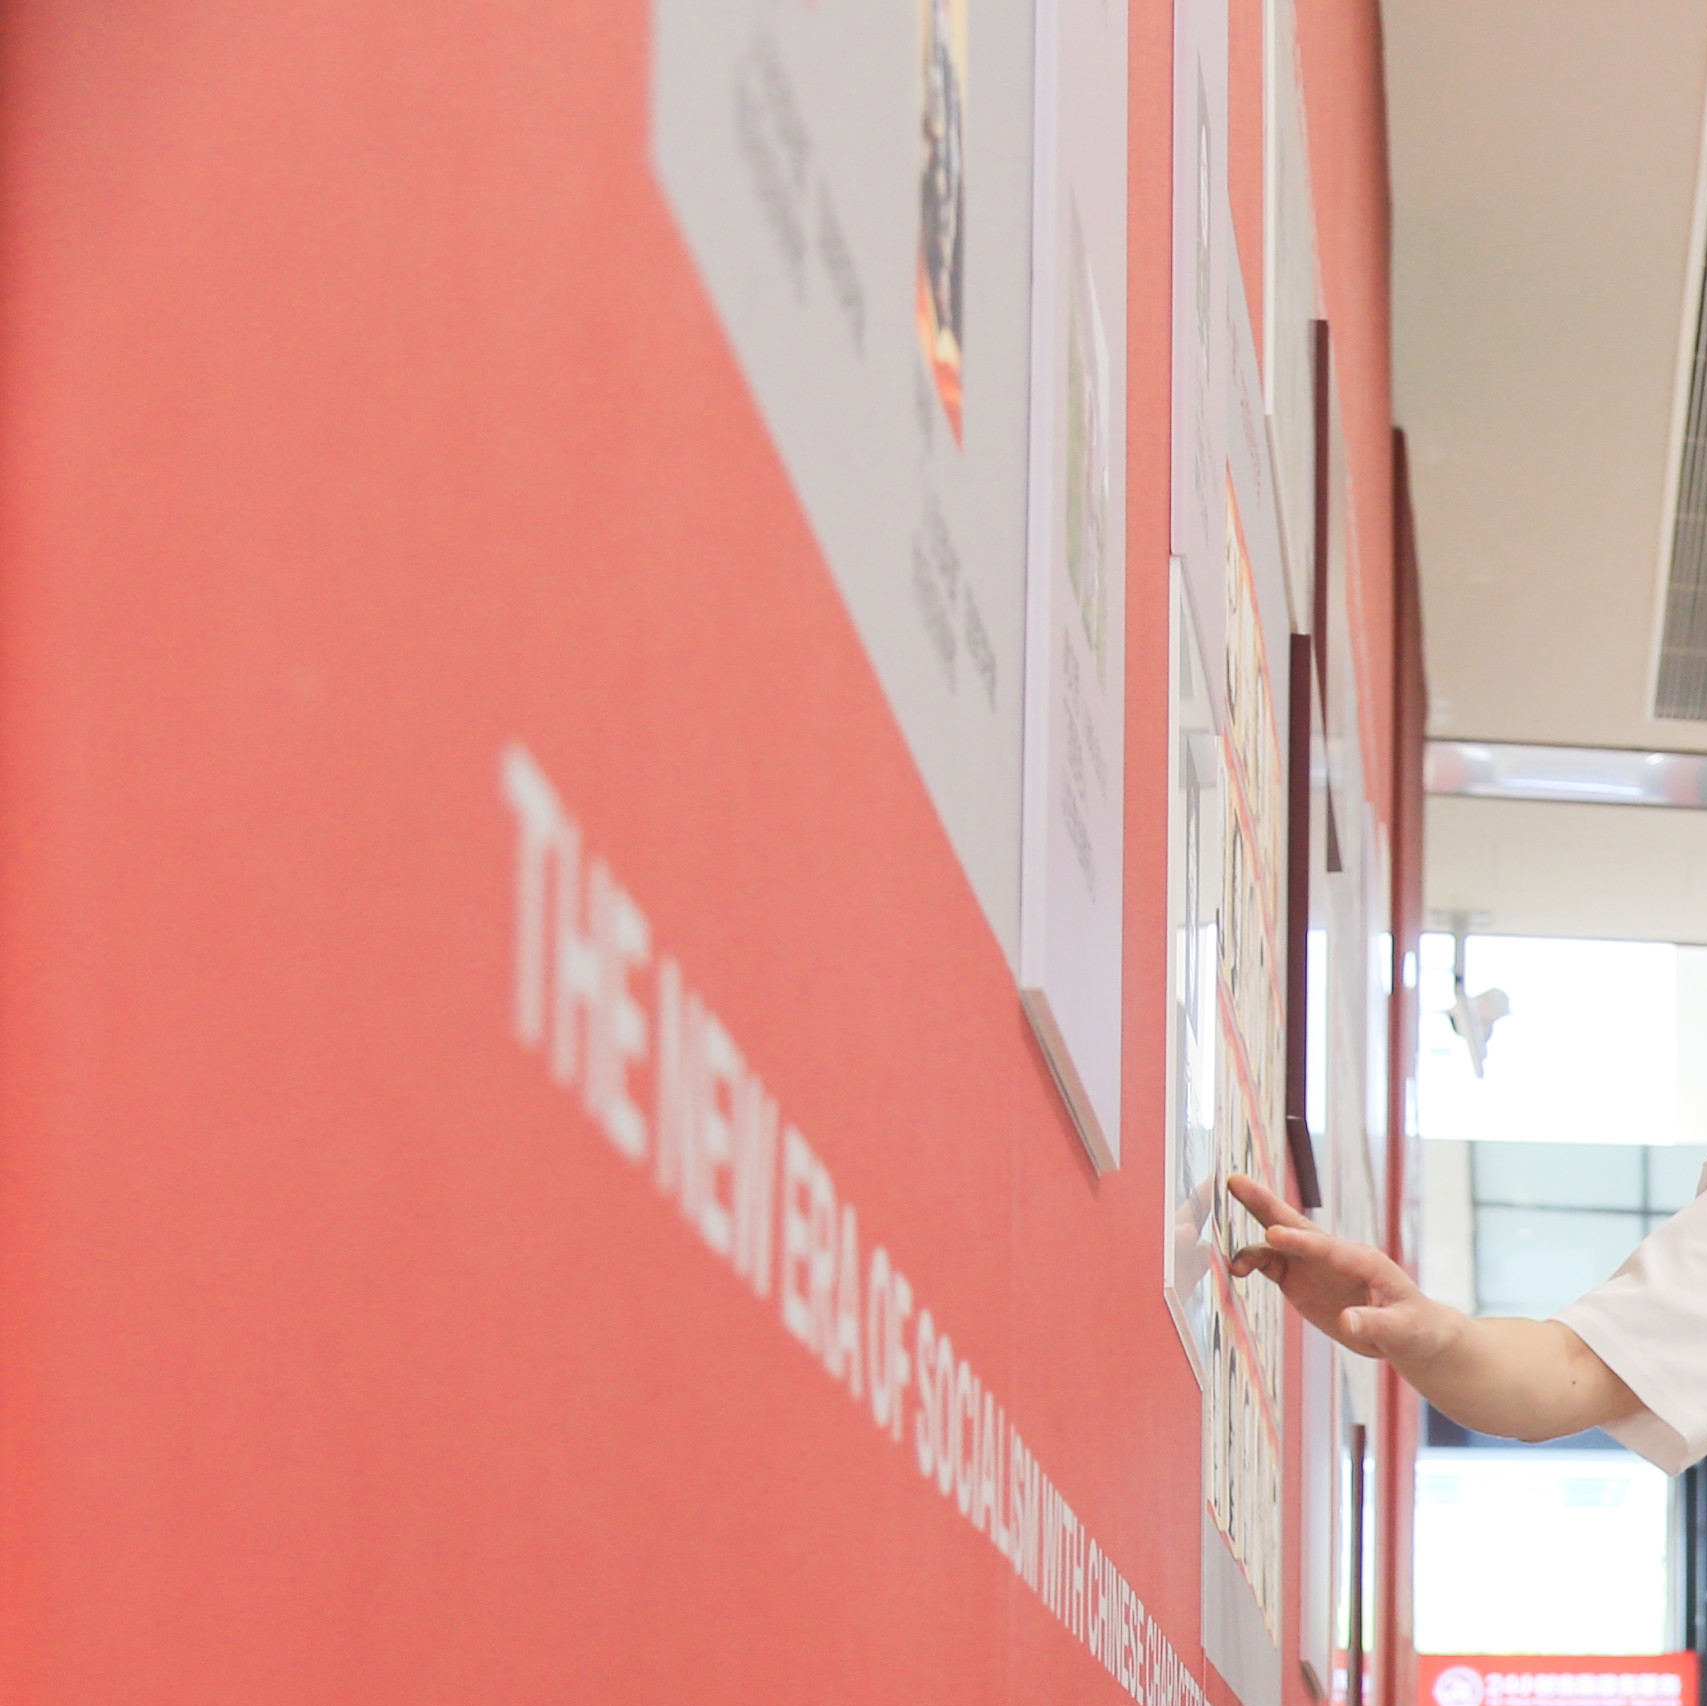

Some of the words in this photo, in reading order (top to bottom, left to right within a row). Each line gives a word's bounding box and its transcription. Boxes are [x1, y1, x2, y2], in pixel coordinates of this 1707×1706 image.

[500, 741, 649, 1164] THE
[656, 955, 779, 1300] NEW
[781, 1122, 864, 1399] ERA
[867, 1244, 914, 1444] OF
[915, 1309, 1040, 1593] SOCIALISM
[1042, 1473, 1085, 1643] WITH
[1088, 1537, 1145, 1706] CHINESE
